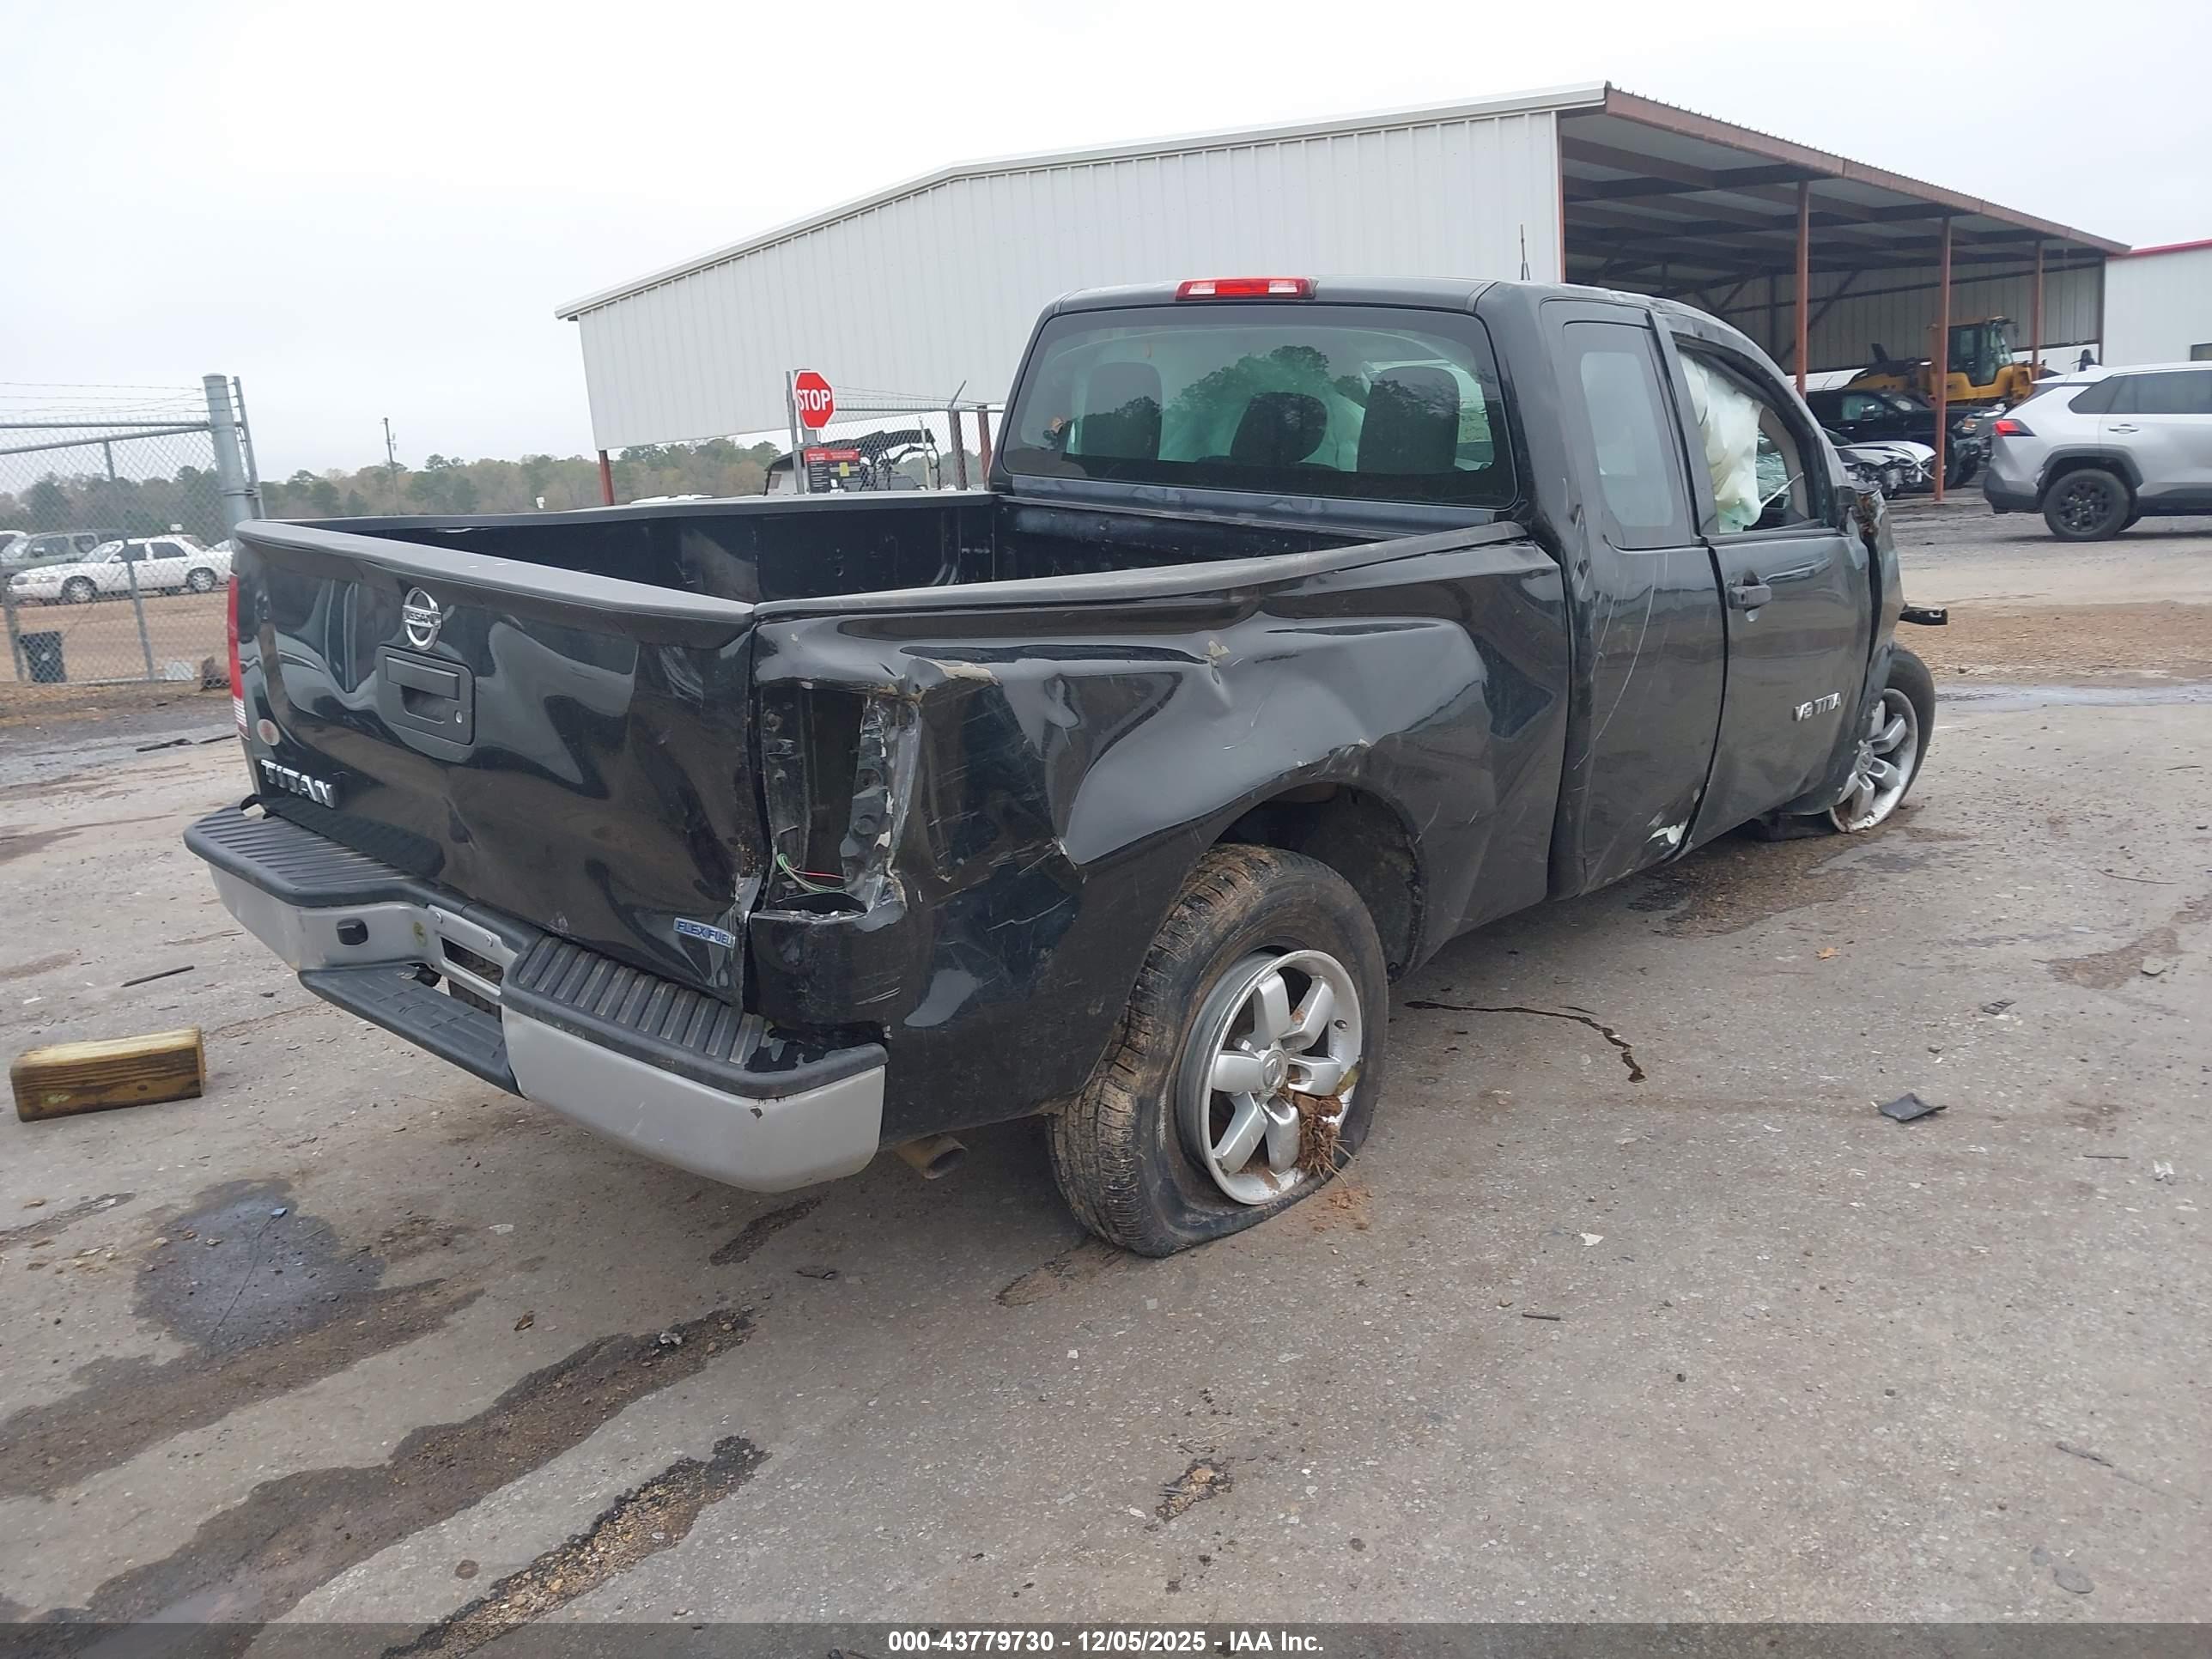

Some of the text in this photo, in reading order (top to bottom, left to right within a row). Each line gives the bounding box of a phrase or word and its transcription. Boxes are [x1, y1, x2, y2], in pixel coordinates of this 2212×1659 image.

[797, 389, 831, 411] STOP
[260, 759, 335, 808] TITAN
[678, 920, 732, 945] FLEX FUEL
